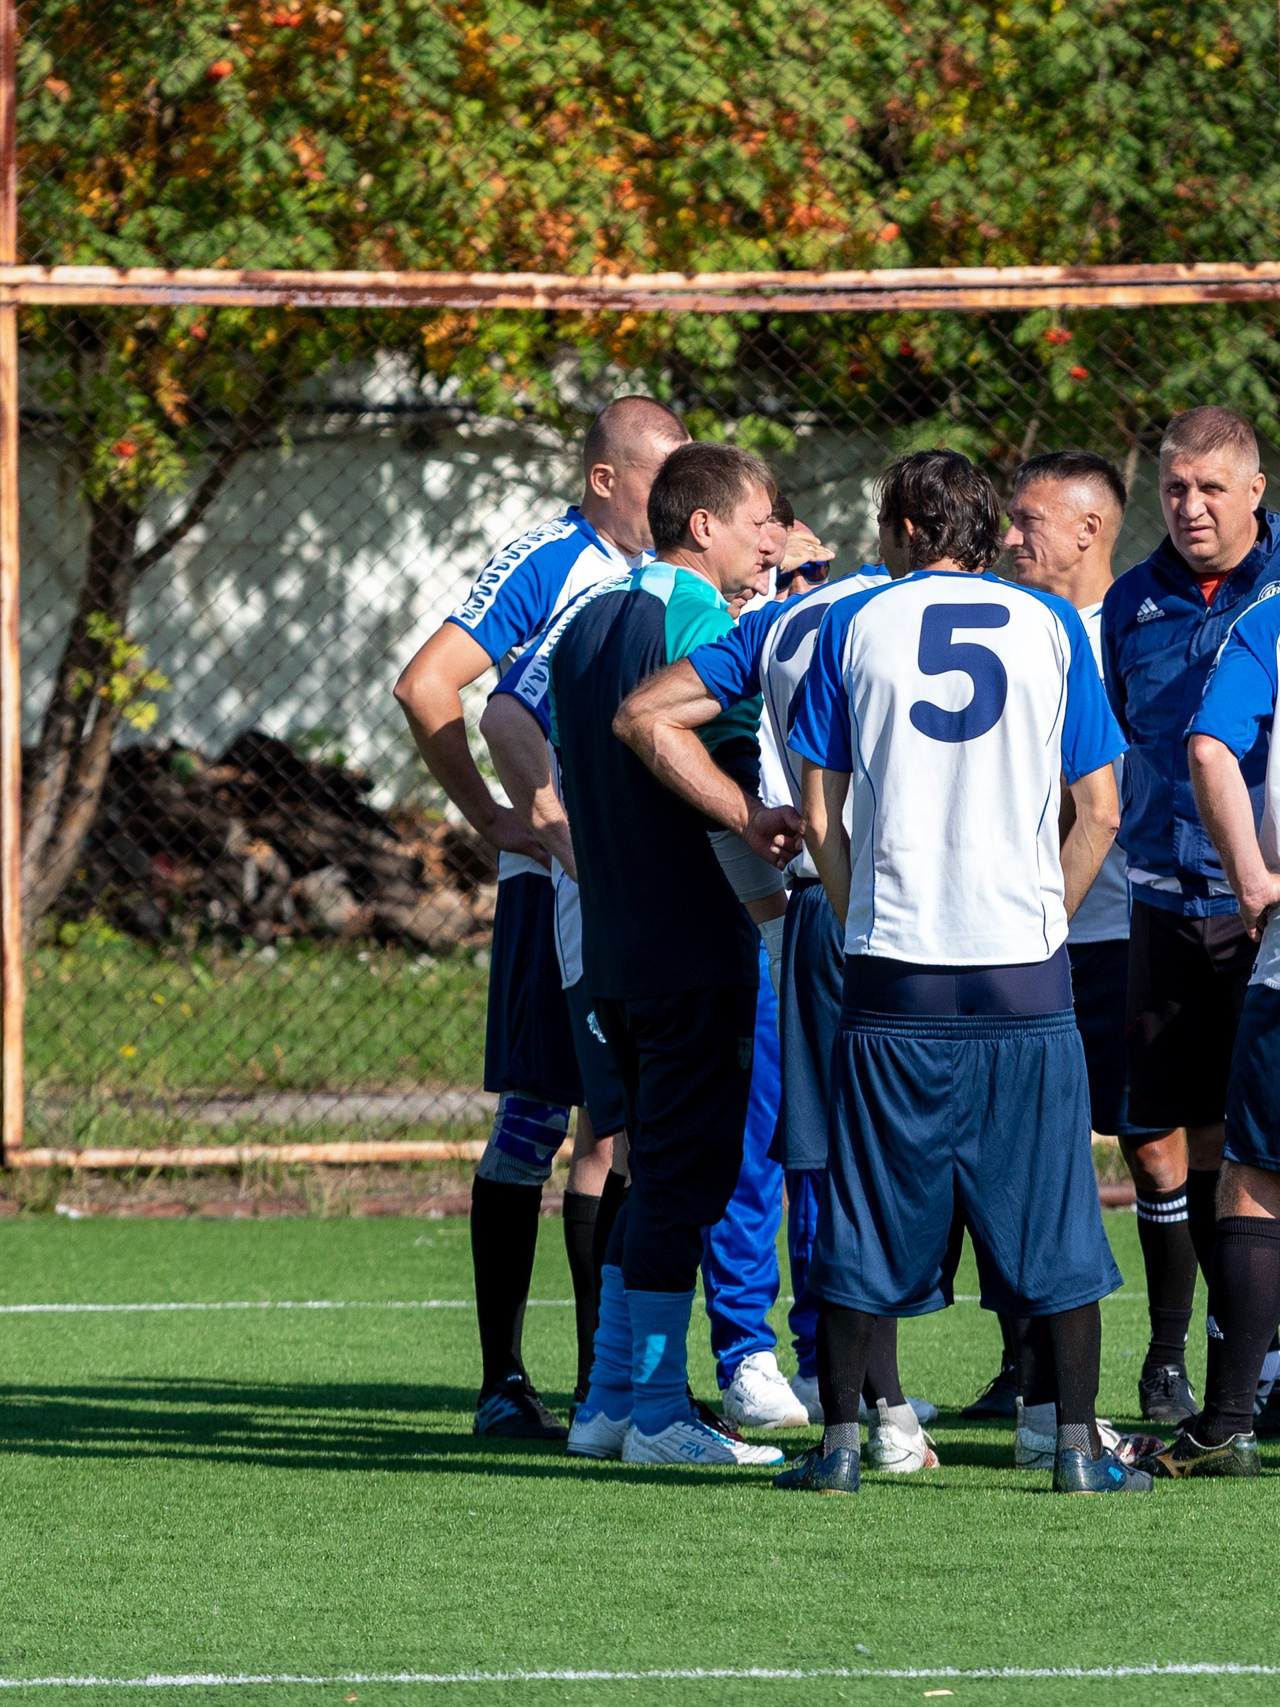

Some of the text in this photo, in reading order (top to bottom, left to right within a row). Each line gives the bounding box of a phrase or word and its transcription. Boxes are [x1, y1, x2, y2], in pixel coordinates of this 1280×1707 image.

[1136, 609, 1166, 623] adidas
[909, 603, 1010, 743] 5
[679, 1441, 706, 1458] FN
